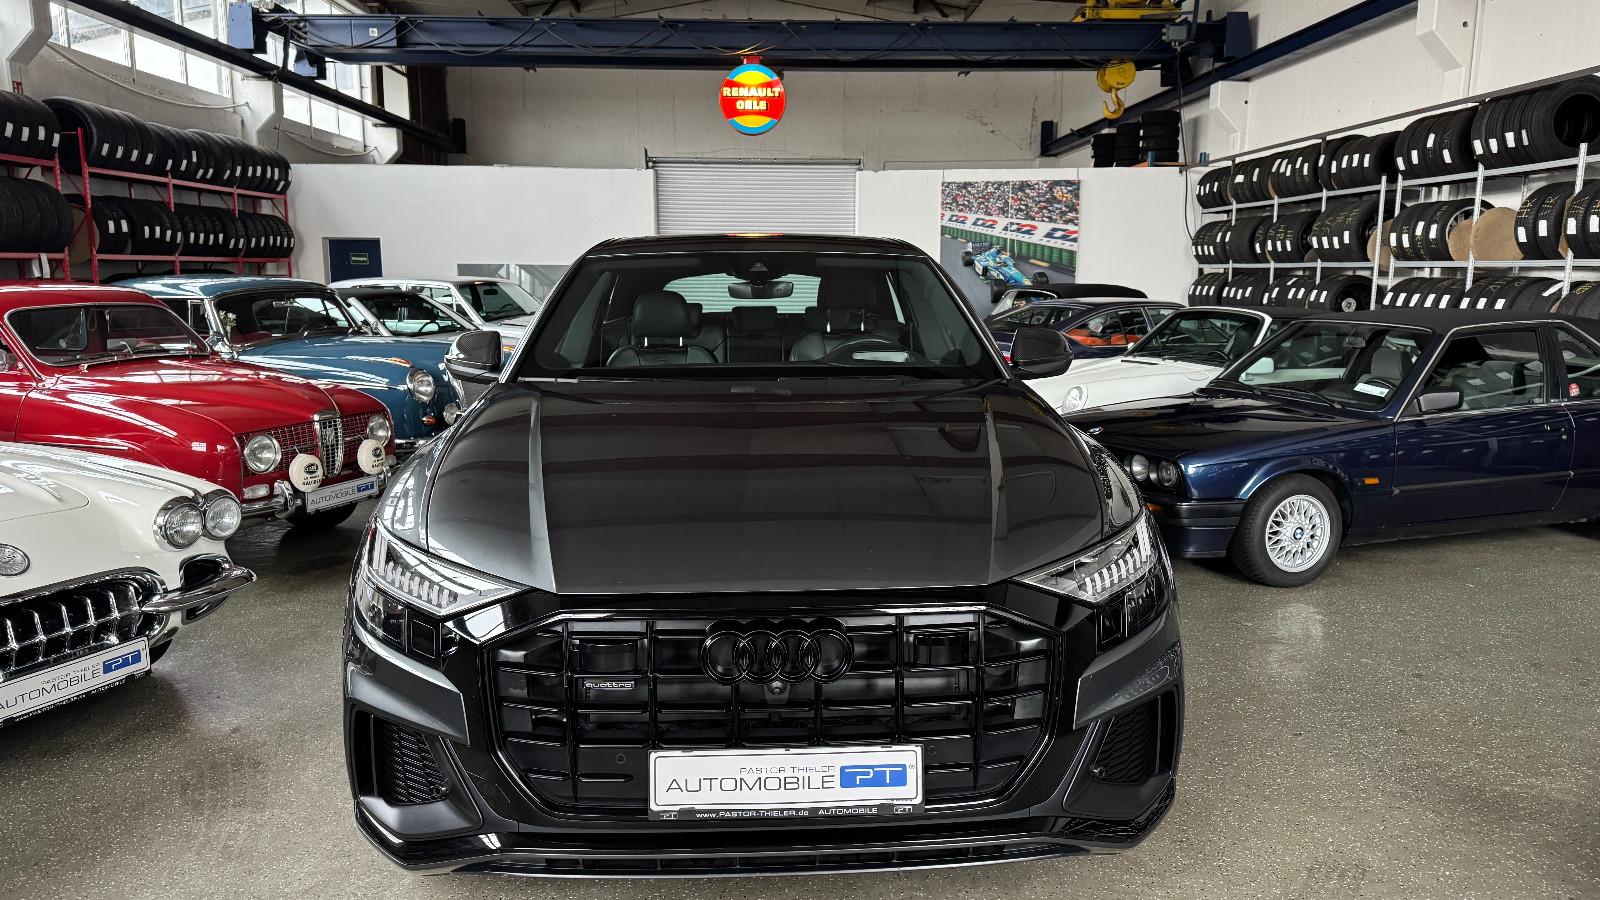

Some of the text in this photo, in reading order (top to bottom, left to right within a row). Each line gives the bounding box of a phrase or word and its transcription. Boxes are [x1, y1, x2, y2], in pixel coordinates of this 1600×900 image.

[723, 87, 780, 97] RENAULT
[105, 651, 140, 670] PT
[739, 767, 786, 775] PASTOR
[666, 767, 903, 793] AUTOMOBILE PT
[695, 810, 809, 818] www.PASTOR-THIELER.de
[818, 807, 878, 815] AUTOMOBILE
